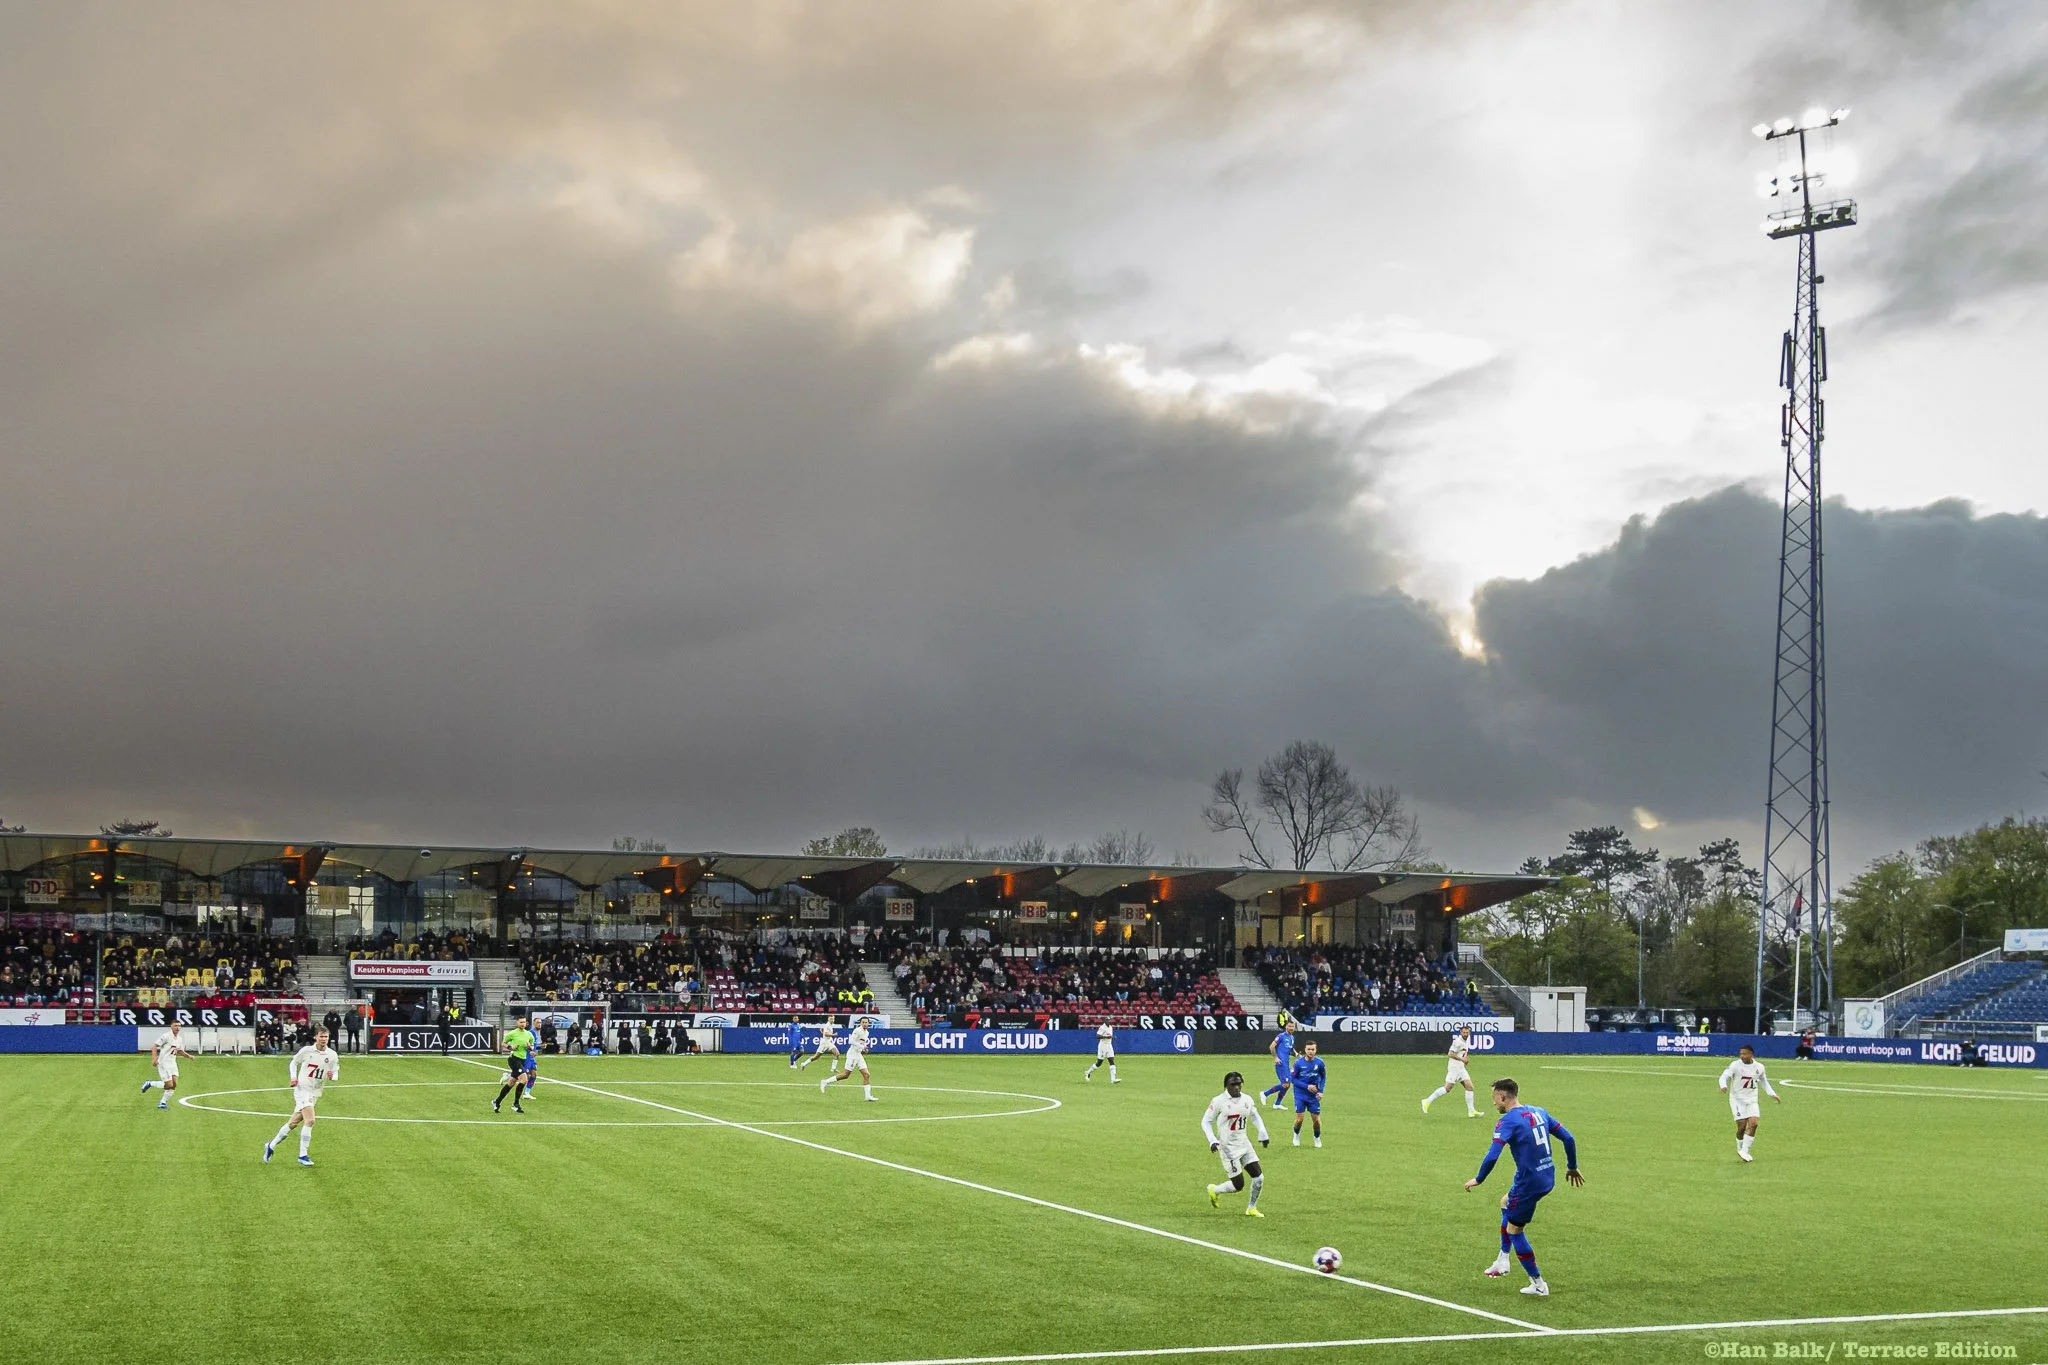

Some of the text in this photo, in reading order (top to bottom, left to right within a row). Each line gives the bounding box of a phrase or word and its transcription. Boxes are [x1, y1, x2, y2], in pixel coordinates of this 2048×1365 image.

[892, 902, 900, 916] B
[906, 902, 913, 916] B
[1027, 906, 1034, 918] B
[358, 966, 467, 974] Keuken Kampioen divisie
[1035, 1014, 1060, 1030] 711
[1352, 1021, 1499, 1033] BEST GLOBAL LOGISTICS
[372, 1028, 490, 1049] 711 STADION
[764, 1033, 810, 1045] verhr
[881, 1038, 901, 1046] van
[914, 1032, 967, 1049] LICHT
[982, 1033, 1048, 1050] GELUID
[1176, 1034, 1190, 1048] M
[1656, 1036, 1710, 1046] M-SOUND
[1813, 1042, 1844, 1054] verhuur
[1846, 1045, 1856, 1054] en
[1858, 1042, 1894, 1058] verkoop
[1895, 1047, 1912, 1056] van
[1978, 1044, 2036, 1064] GELUID
[308, 1064, 324, 1080] 711
[1532, 1126, 1550, 1154] 4
